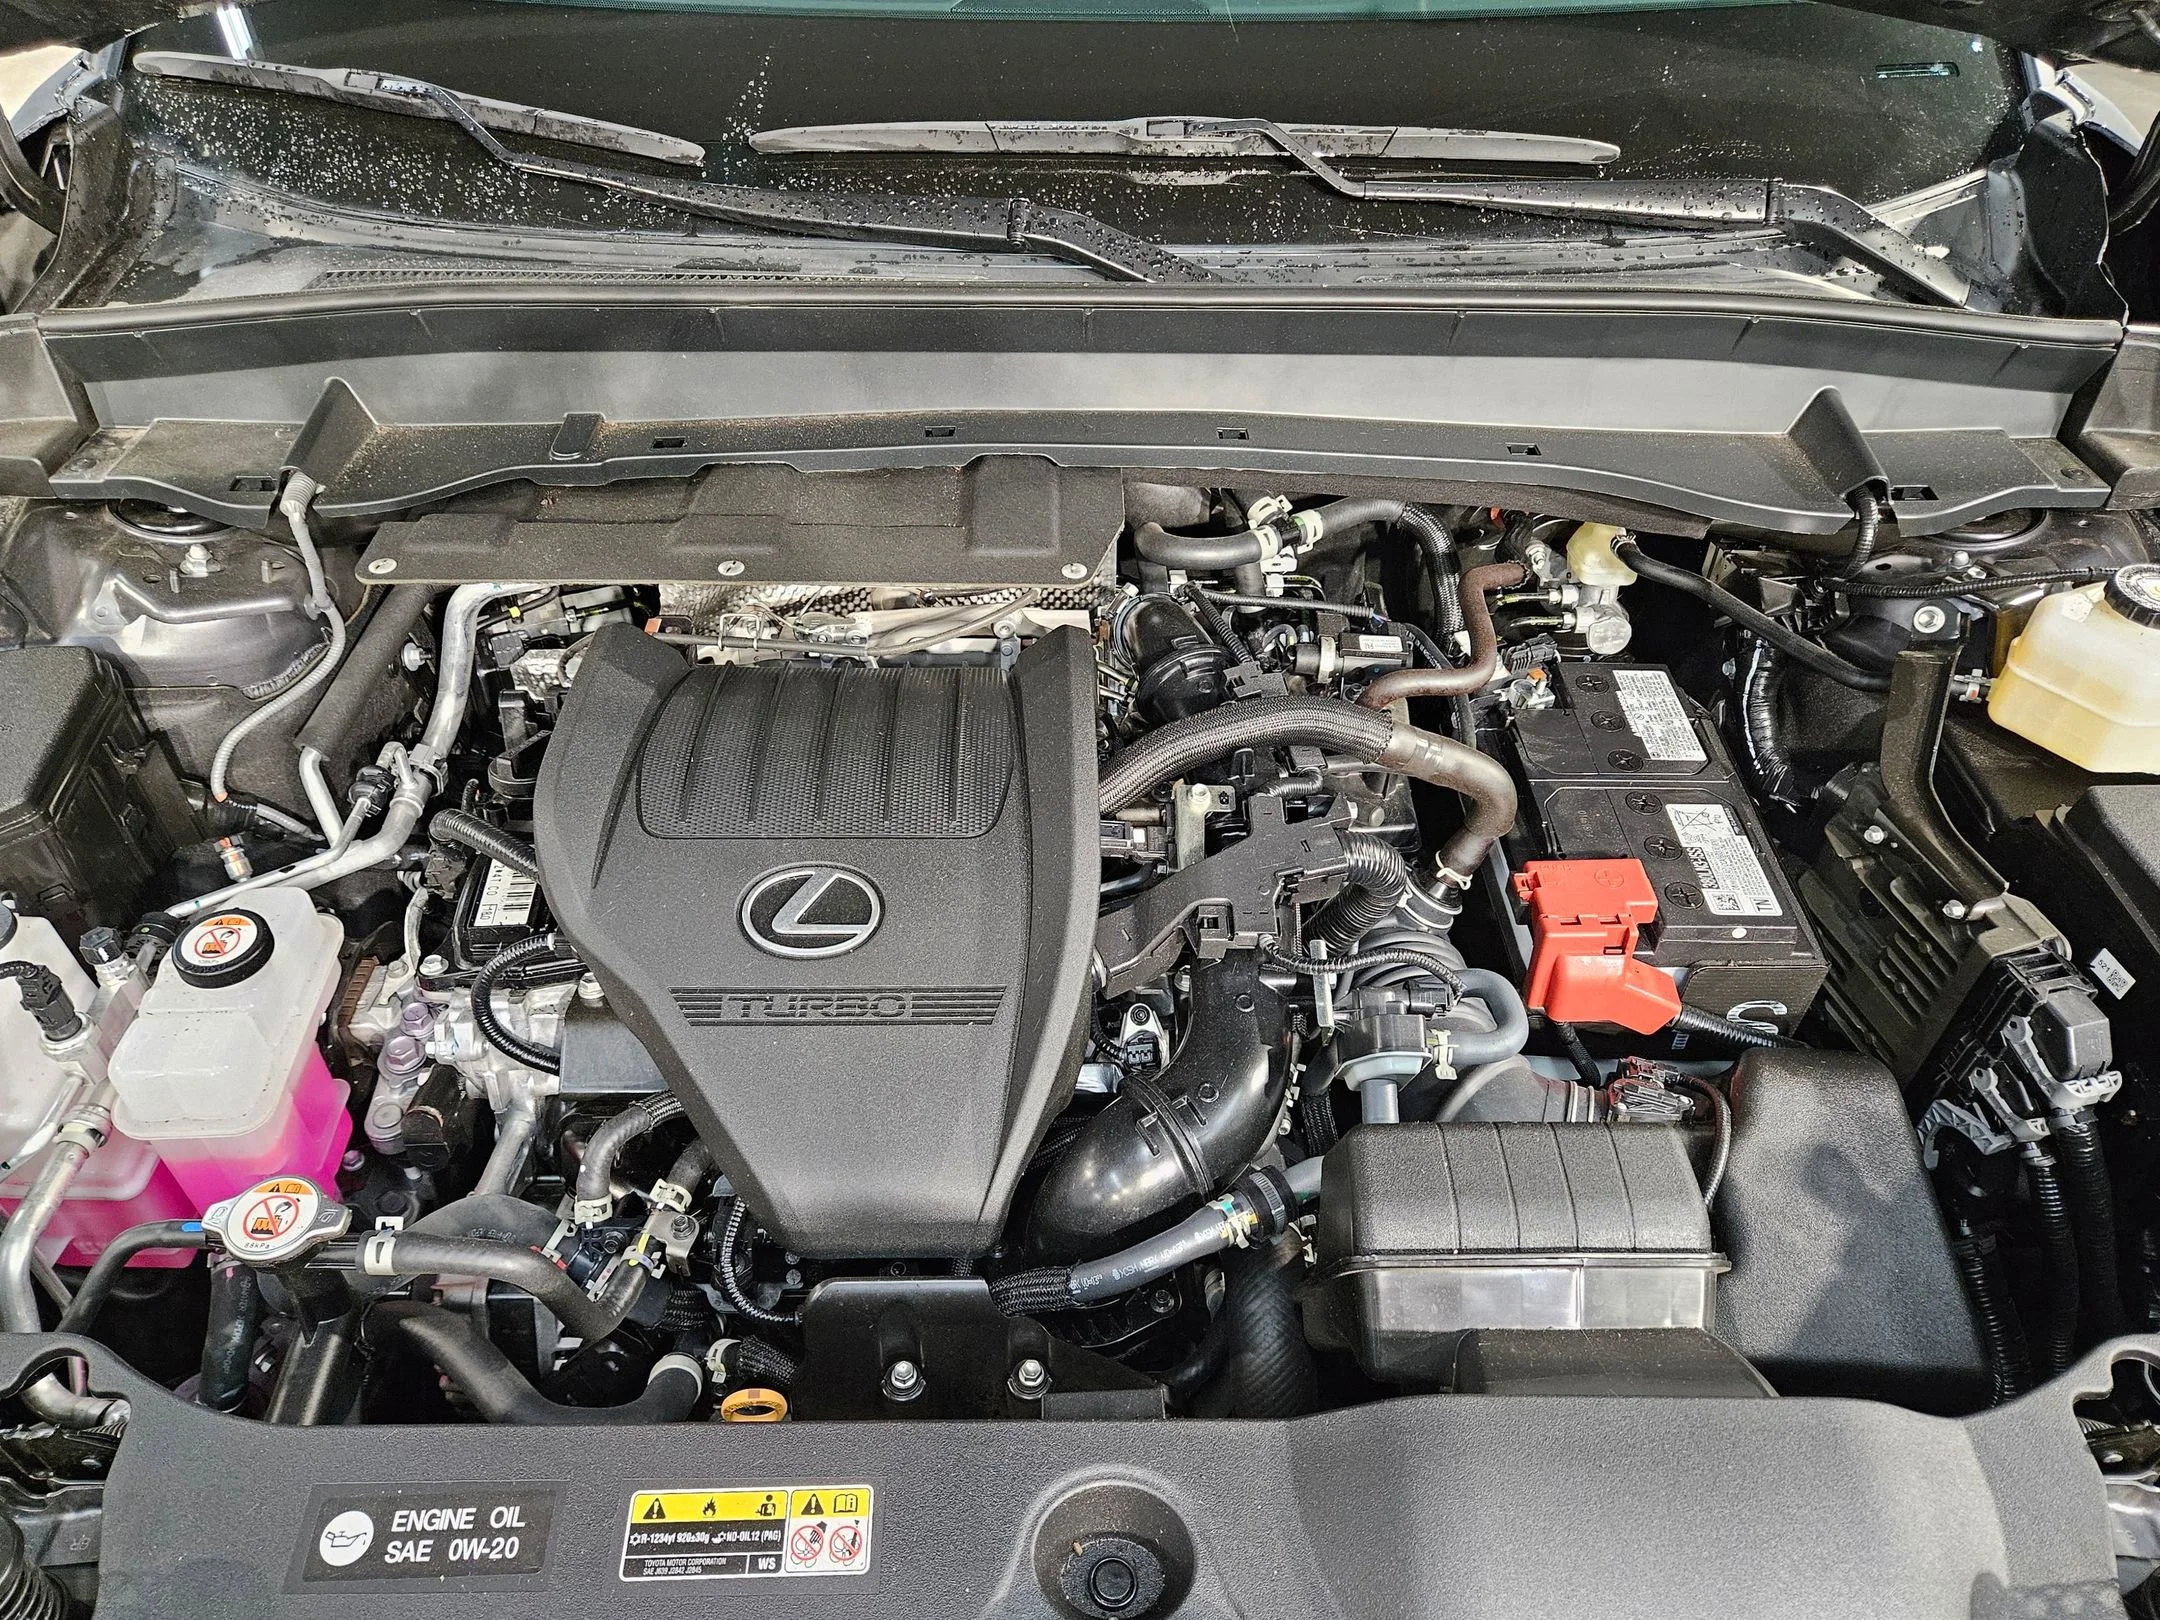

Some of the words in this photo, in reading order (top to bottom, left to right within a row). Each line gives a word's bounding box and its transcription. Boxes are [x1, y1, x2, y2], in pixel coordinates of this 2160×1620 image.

[2098, 959, 2111, 972] 521
[727, 993, 907, 1018] TURBO
[391, 1508, 476, 1531] ENGINE
[490, 1506, 526, 1528] OIL
[761, 1530, 782, 1543] (PAG)
[384, 1540, 433, 1563] SAE
[448, 1536, 520, 1561] 0W-20
[644, 1558, 666, 1567] TOYOTA
[666, 1558, 687, 1566] MOTOR
[687, 1557, 727, 1566] CORPORATION
[758, 1556, 776, 1570] WS
